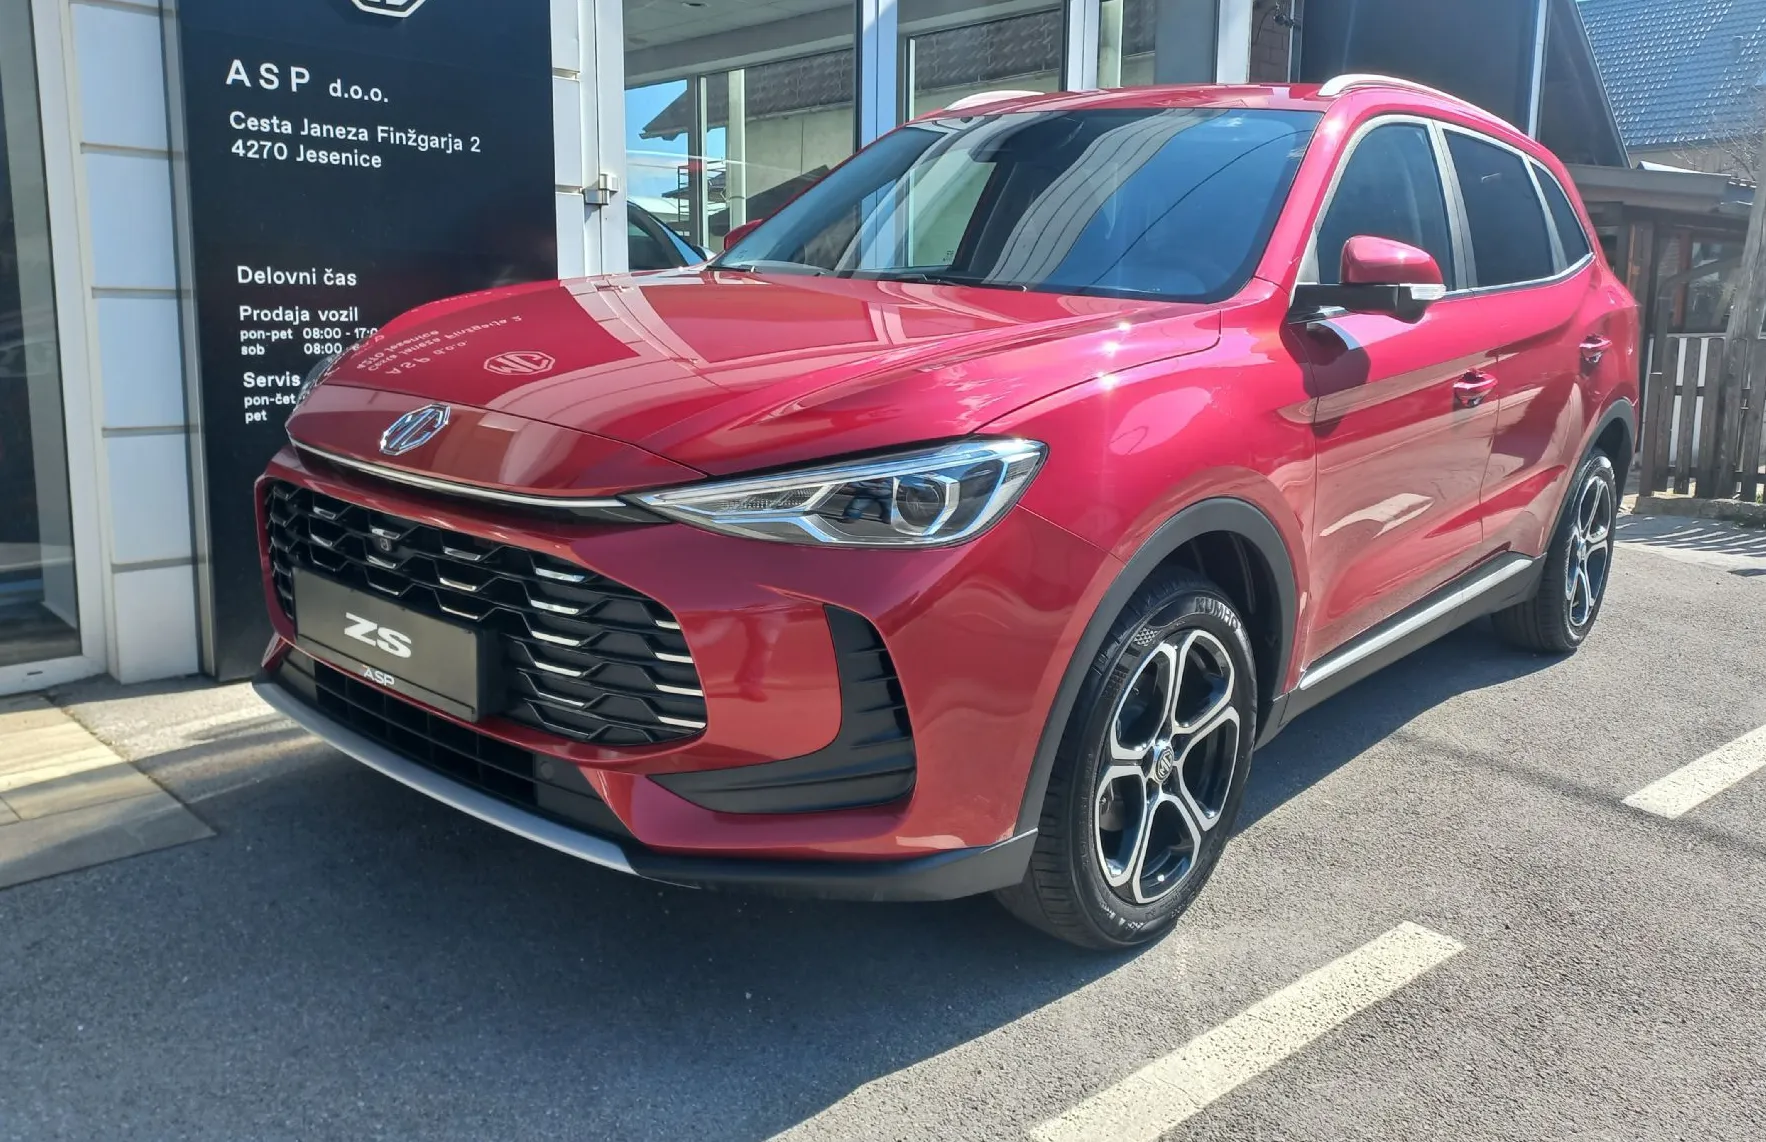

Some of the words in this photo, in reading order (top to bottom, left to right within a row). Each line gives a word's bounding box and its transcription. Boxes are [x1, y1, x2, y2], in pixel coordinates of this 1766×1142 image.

[328, 78, 389, 103] d.o.o.
[229, 111, 292, 135] Cesta
[300, 118, 368, 142] Janeza
[377, 126, 463, 153] Finžgarja
[469, 136, 481, 152] 2
[231, 139, 288, 160] 4270
[296, 145, 382, 168] Jesenice
[237, 265, 317, 285] Delovni
[323, 268, 357, 286] čas
[239, 305, 310, 325] Prodaja
[317, 306, 358, 322] vozil
[240, 328, 293, 341] pon-pet
[302, 328, 341, 339] 08:00
[354, 328, 378, 339] 17:0
[241, 344, 265, 355] sob
[304, 343, 343, 355] 08:00
[243, 371, 301, 388] Servis
[244, 393, 296, 408] pon-čet
[245, 410, 267, 424] pet
[344, 612, 412, 659] ZS
[363, 667, 395, 686] ASP
